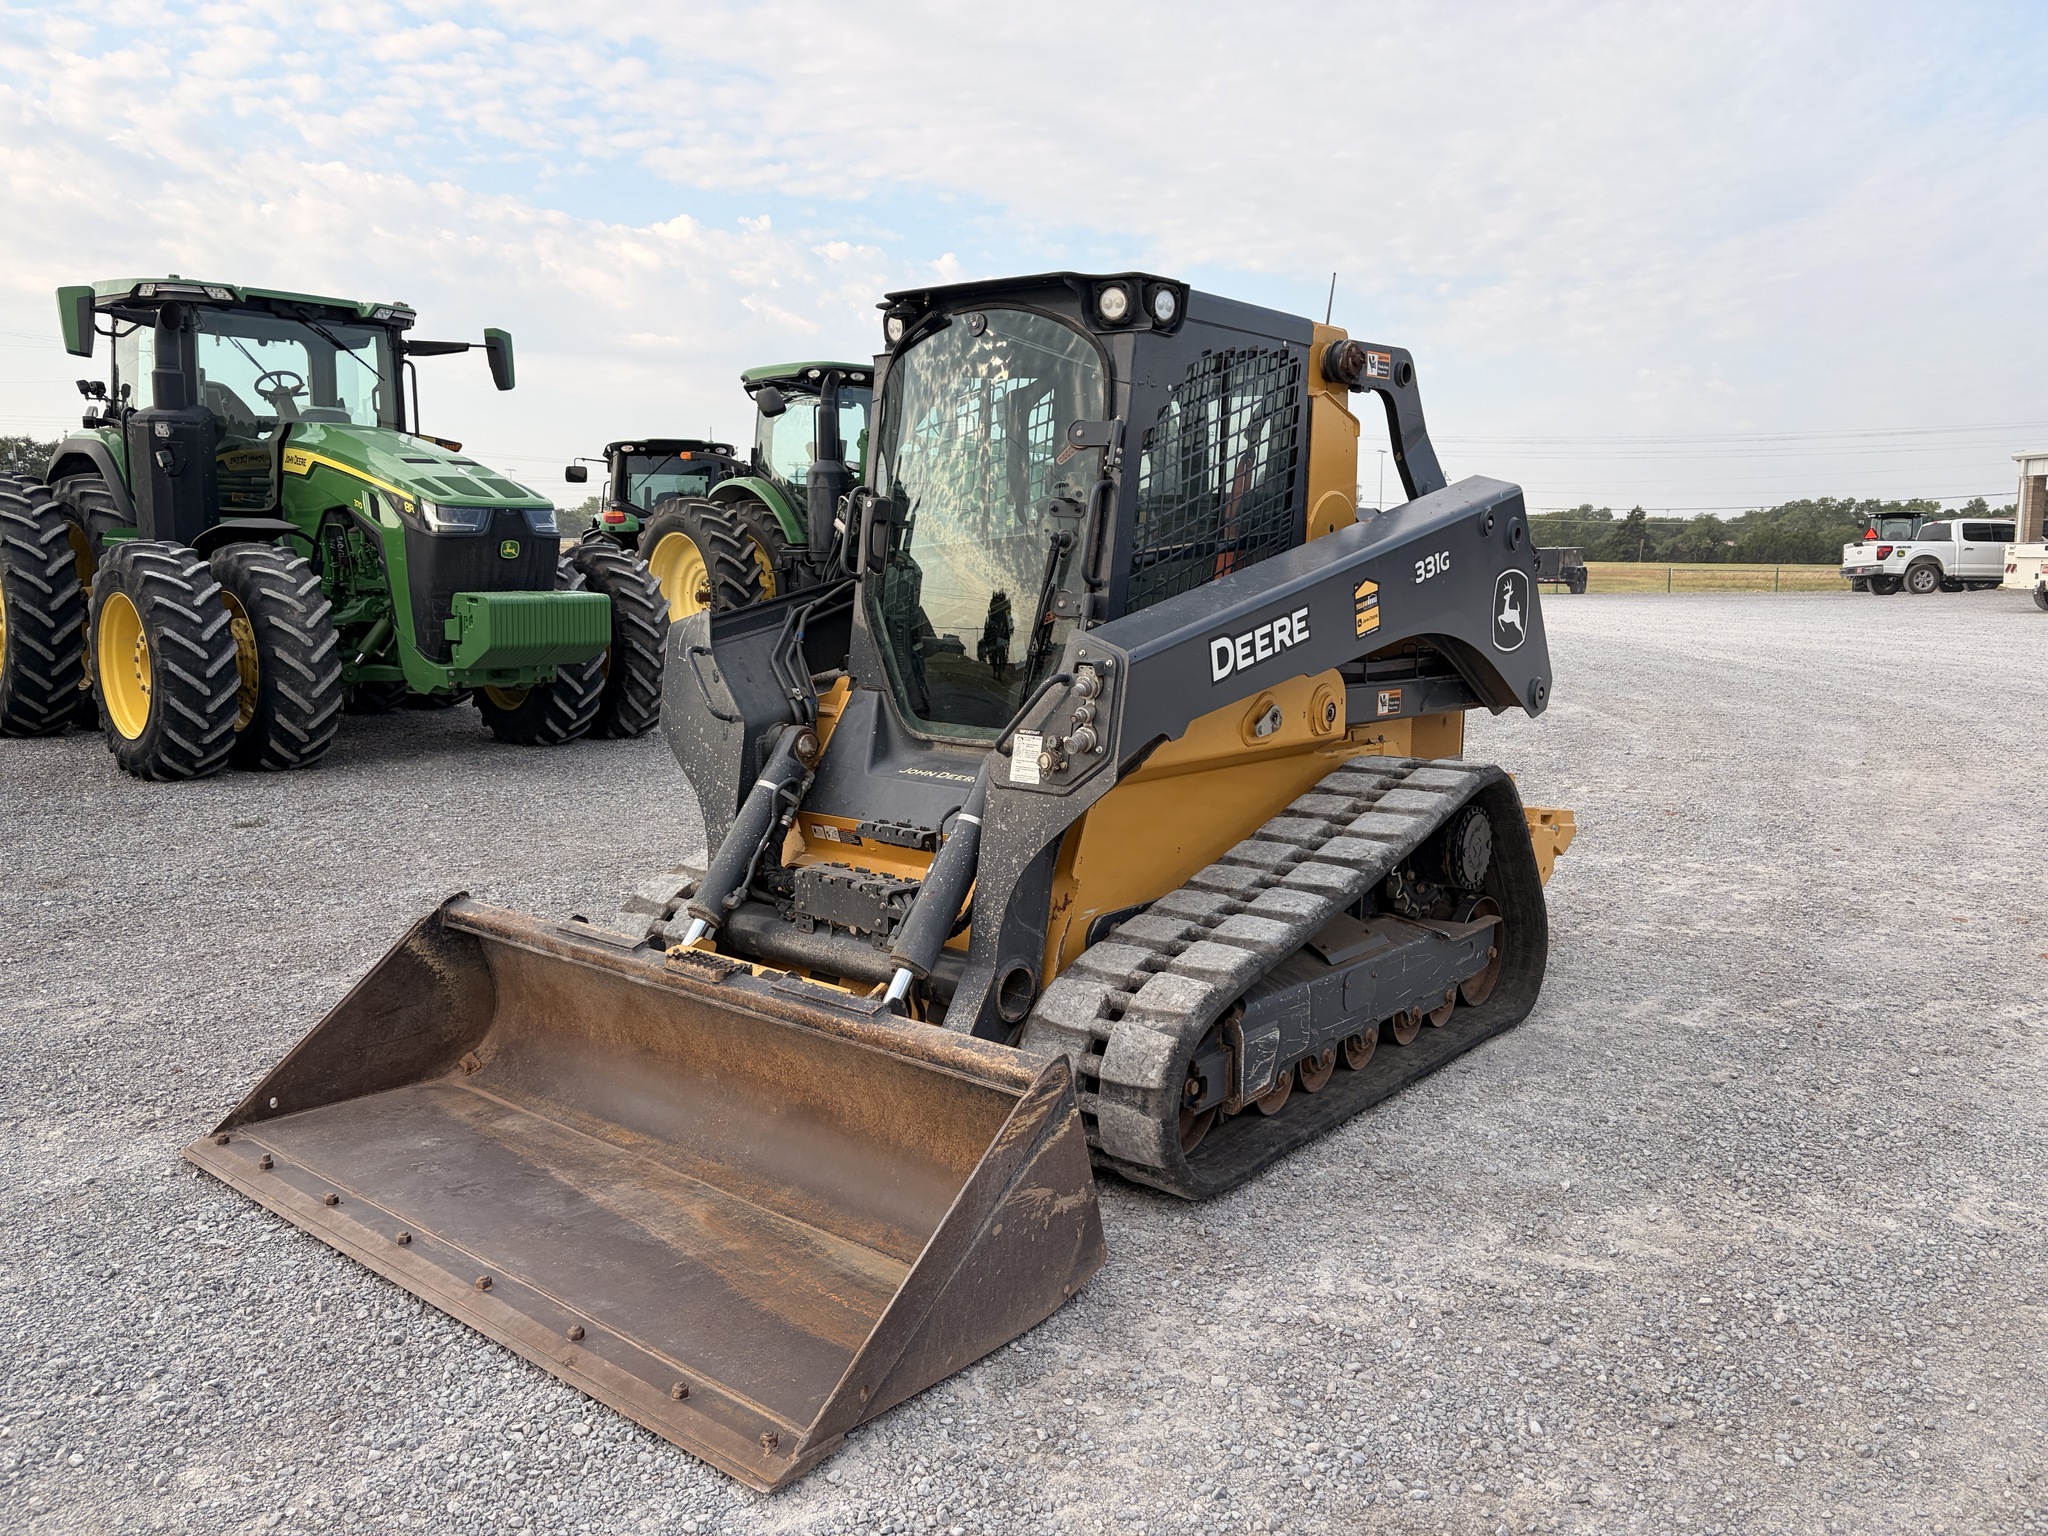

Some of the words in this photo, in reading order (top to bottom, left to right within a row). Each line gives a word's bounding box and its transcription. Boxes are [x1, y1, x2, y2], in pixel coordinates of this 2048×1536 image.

[285, 454, 294, 464] JOHN
[294, 454, 307, 467] DEERE
[403, 501, 415, 514] 8R
[1414, 550, 1450, 584] 331G
[1210, 606, 1310, 682] DEERE
[899, 768, 937, 777] JOHN
[936, 771, 976, 783] DEER
